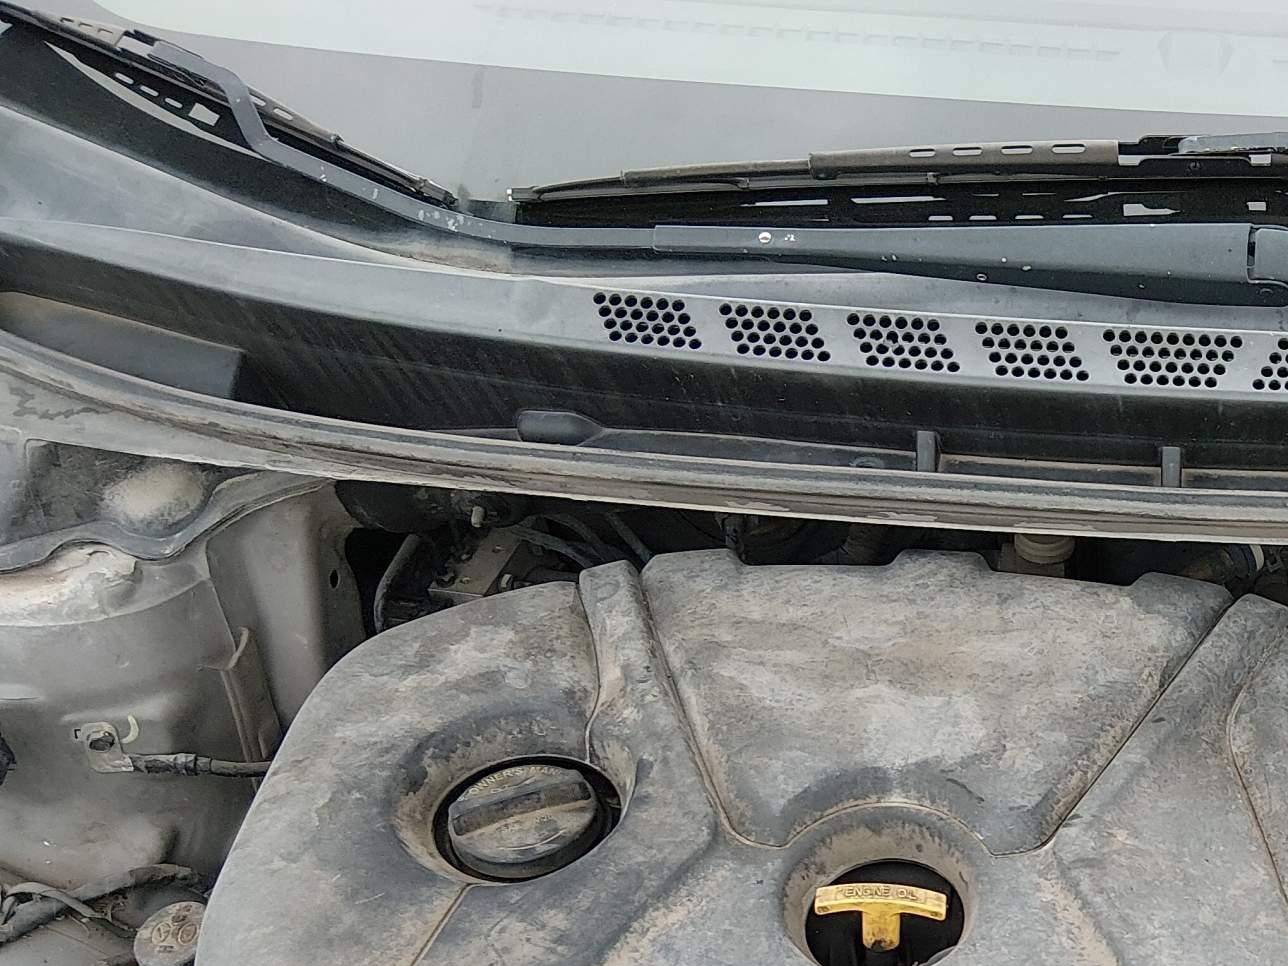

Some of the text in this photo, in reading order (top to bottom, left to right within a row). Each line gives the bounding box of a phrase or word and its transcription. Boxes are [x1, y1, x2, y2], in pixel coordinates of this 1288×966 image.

[469, 767, 525, 795] OWNER'S
[844, 886, 917, 899] ENGINE OIL
